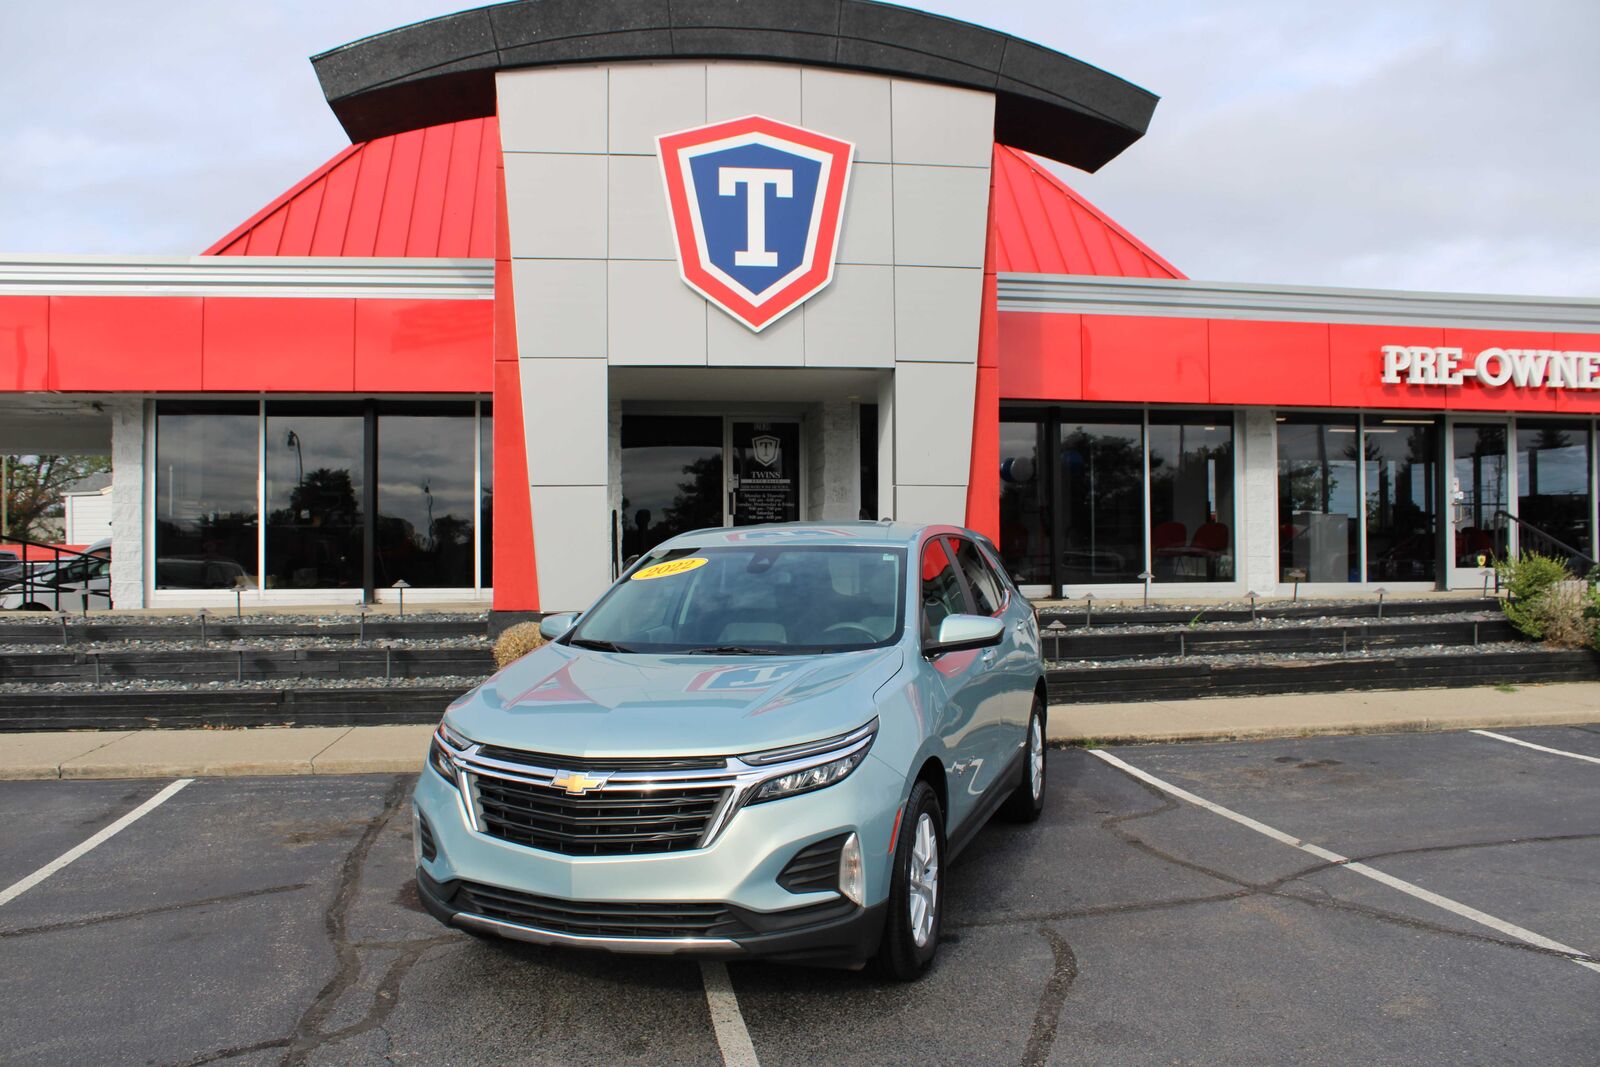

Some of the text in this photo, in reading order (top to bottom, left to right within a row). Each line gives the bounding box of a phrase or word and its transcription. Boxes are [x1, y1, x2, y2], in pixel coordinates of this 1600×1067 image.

[718, 167, 793, 267] T
[1381, 345, 1600, 388] PRE-OWNE
[759, 441, 773, 457] T
[751, 471, 781, 479] TWINS
[643, 560, 697, 578] 2022
